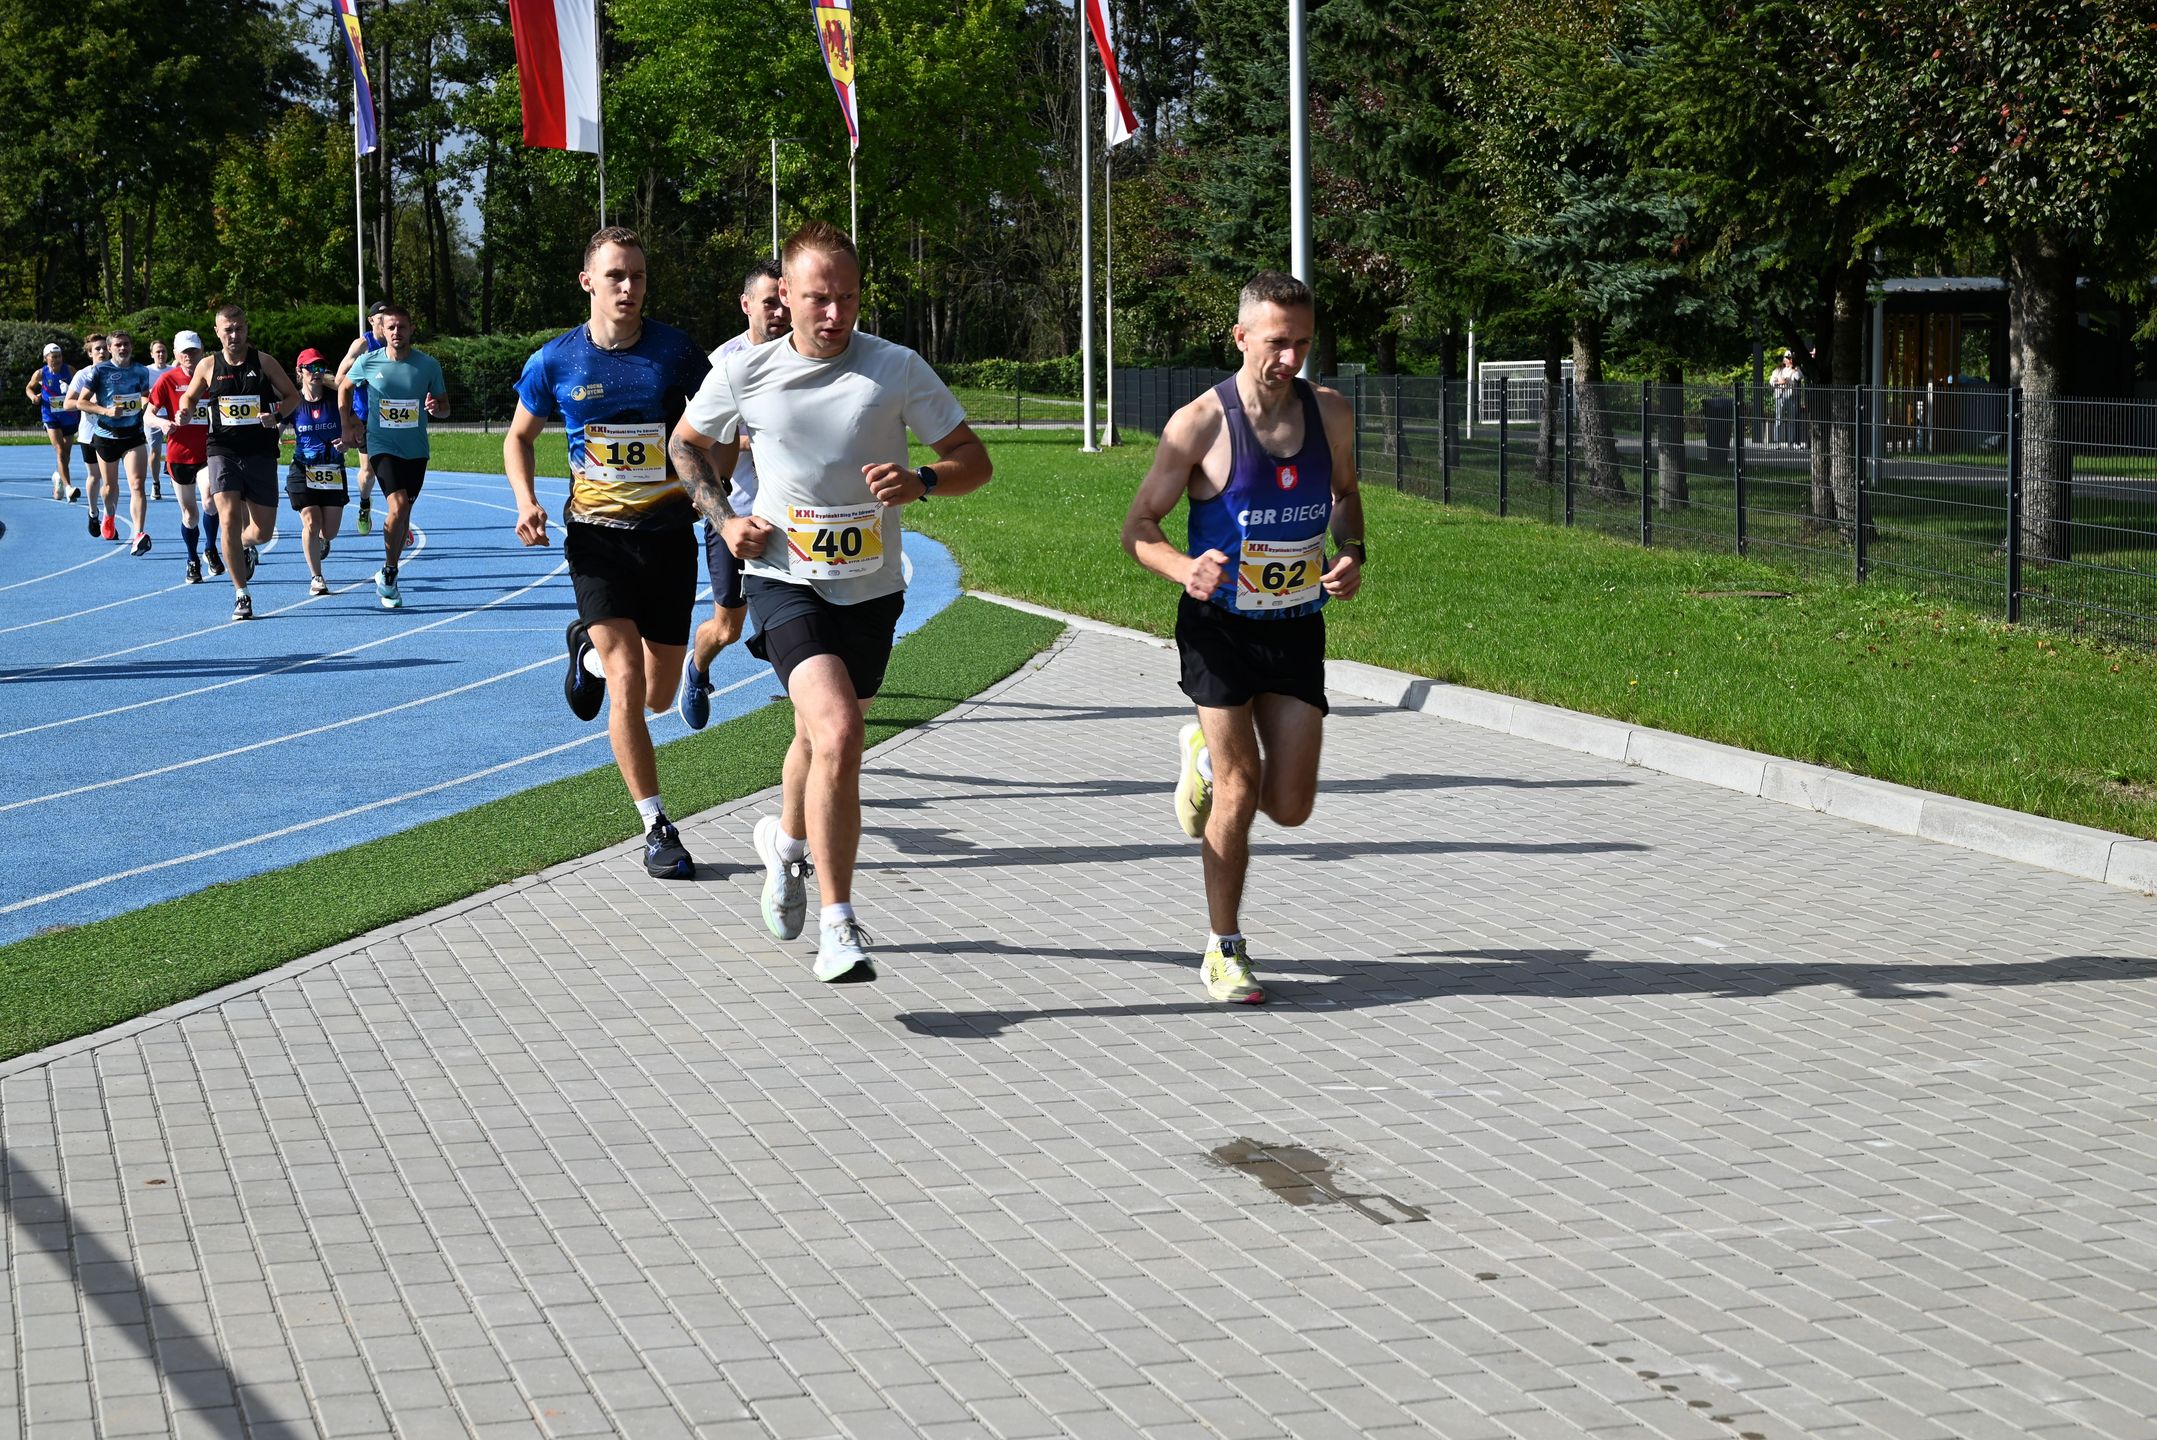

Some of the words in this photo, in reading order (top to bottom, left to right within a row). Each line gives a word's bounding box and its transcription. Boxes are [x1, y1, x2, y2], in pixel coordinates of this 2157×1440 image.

[123, 400, 136, 410] 10
[229, 404, 250, 417] 80
[389, 408, 409, 420] 84
[297, 425, 313, 433] CBR
[315, 422, 337, 430] BIEGA
[606, 442, 646, 465] 18
[315, 471, 334, 482] 85
[795, 510, 815, 518] XXI
[1237, 509, 1277, 527] CBR
[1281, 503, 1327, 523] BIEGA
[812, 527, 862, 558] 40
[1248, 544, 1269, 552] XXI
[1262, 560, 1307, 590] 62
